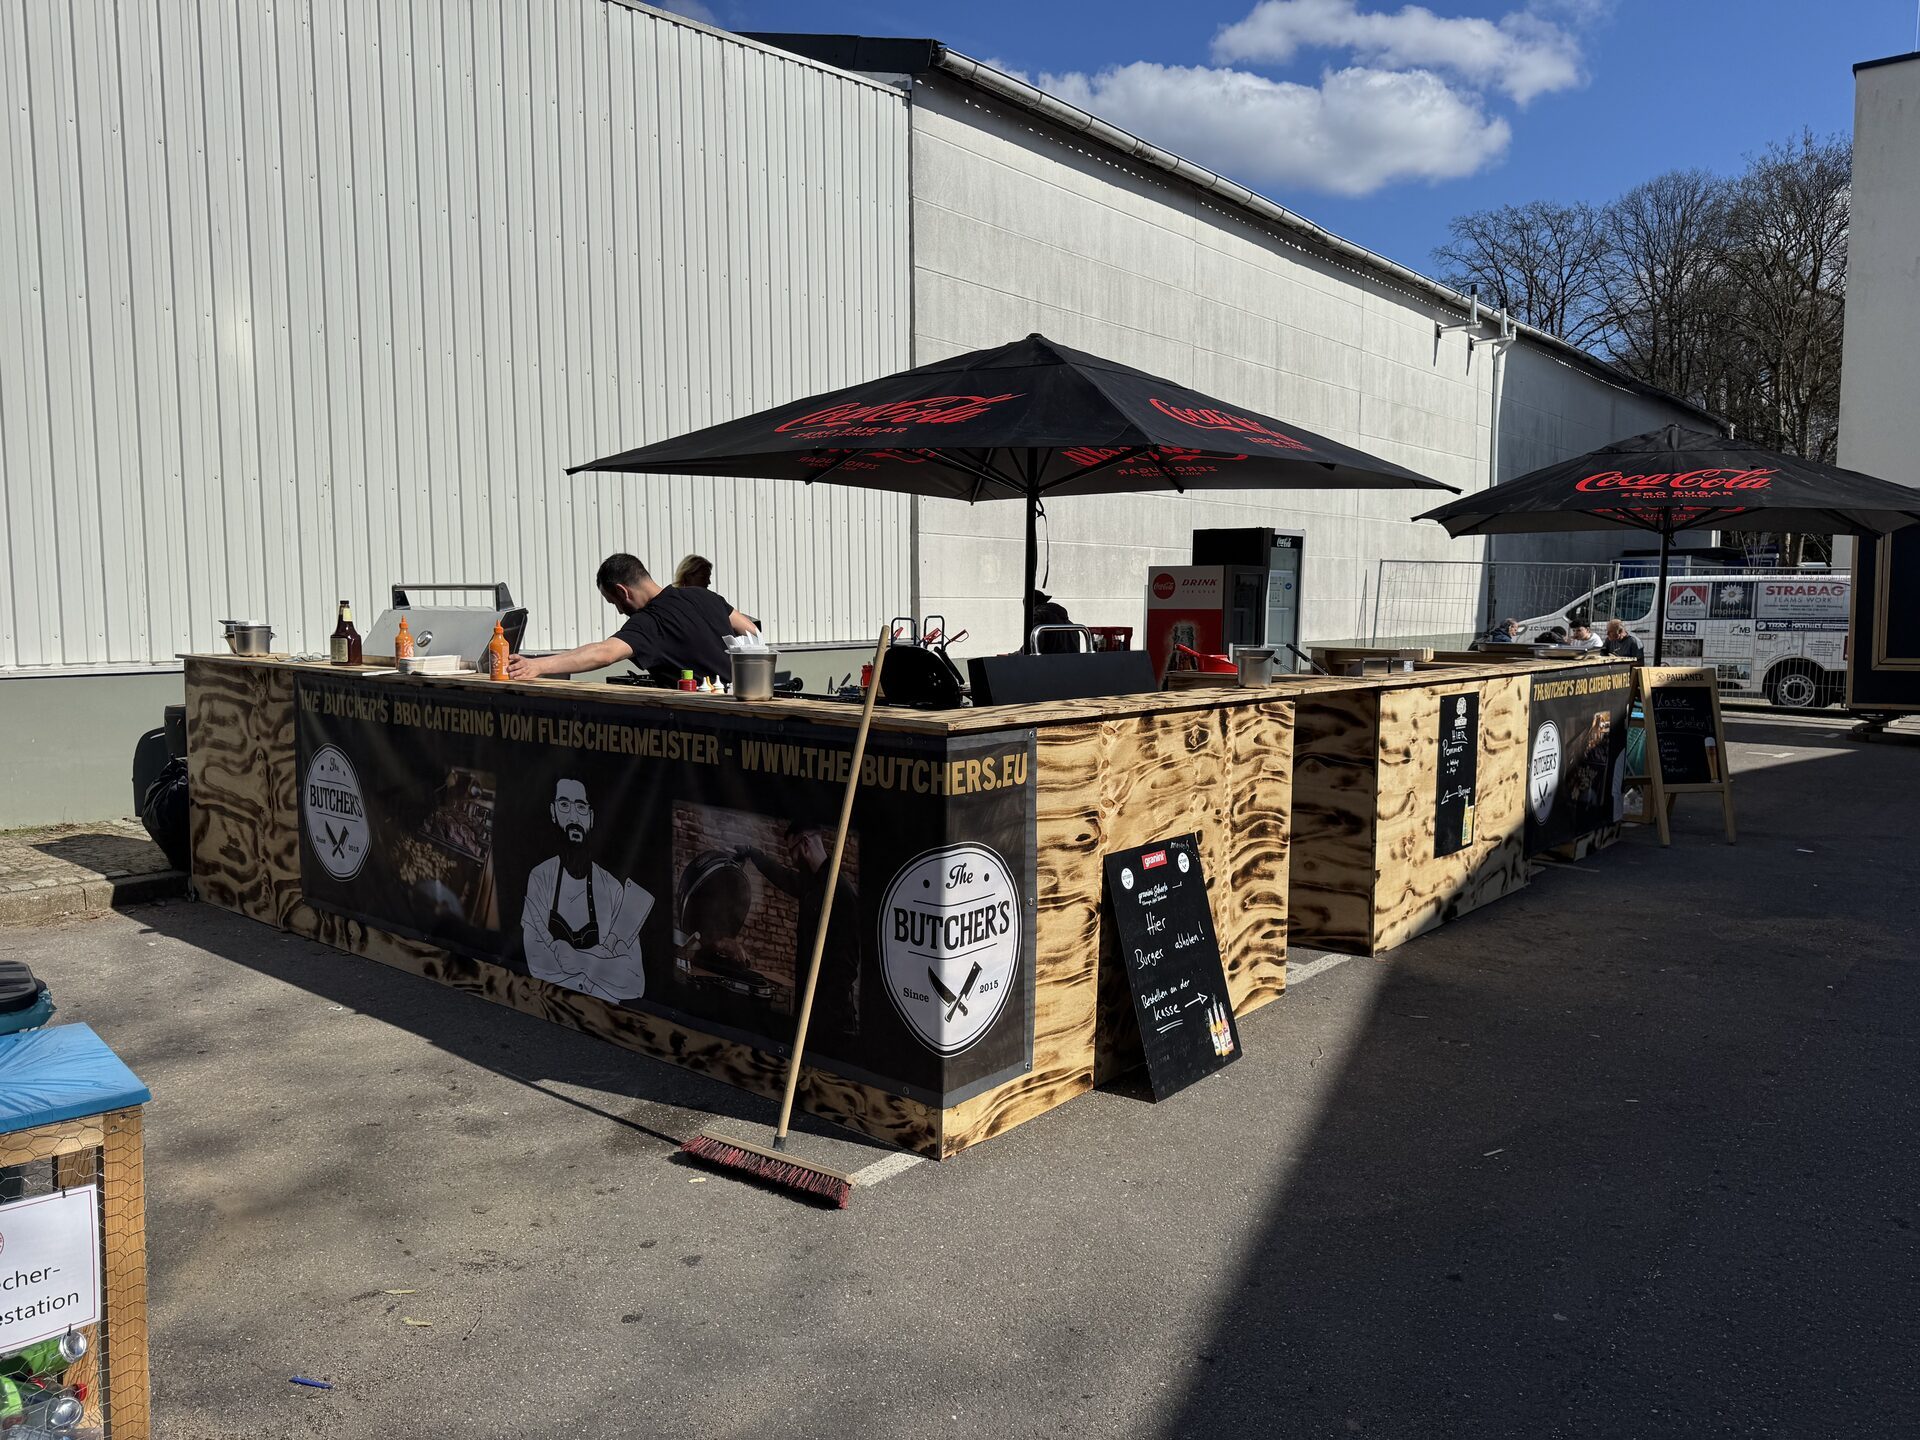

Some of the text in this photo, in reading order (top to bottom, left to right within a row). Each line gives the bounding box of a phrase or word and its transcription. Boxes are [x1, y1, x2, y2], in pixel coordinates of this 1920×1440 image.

[774, 393, 1027, 432] Coca-Cola
[1575, 469, 1782, 492] Coca-Cola
[1182, 578, 1218, 586] DRINK
[1765, 585, 1845, 597] STRABAG
[1680, 595, 1696, 606] HP
[1666, 622, 1695, 632] Hoth
[1575, 678, 1588, 695] BBQ
[1666, 673, 1705, 681] PAULANER
[323, 692, 389, 724] BUTCHER'S
[393, 700, 421, 728] BBQ
[424, 704, 495, 737] CATERING
[500, 712, 533, 742] VOM
[538, 717, 719, 765] FLEISCHERMEISTER
[945, 862, 974, 889] The
[893, 900, 1010, 951] BUTCHER'S
[1146, 911, 1166, 936] Hier
[1134, 948, 1164, 970] Burger
[903, 980, 999, 1003] Since 2015
[1140, 988, 1168, 1009] Bestellen
[1180, 978, 1190, 990] der
